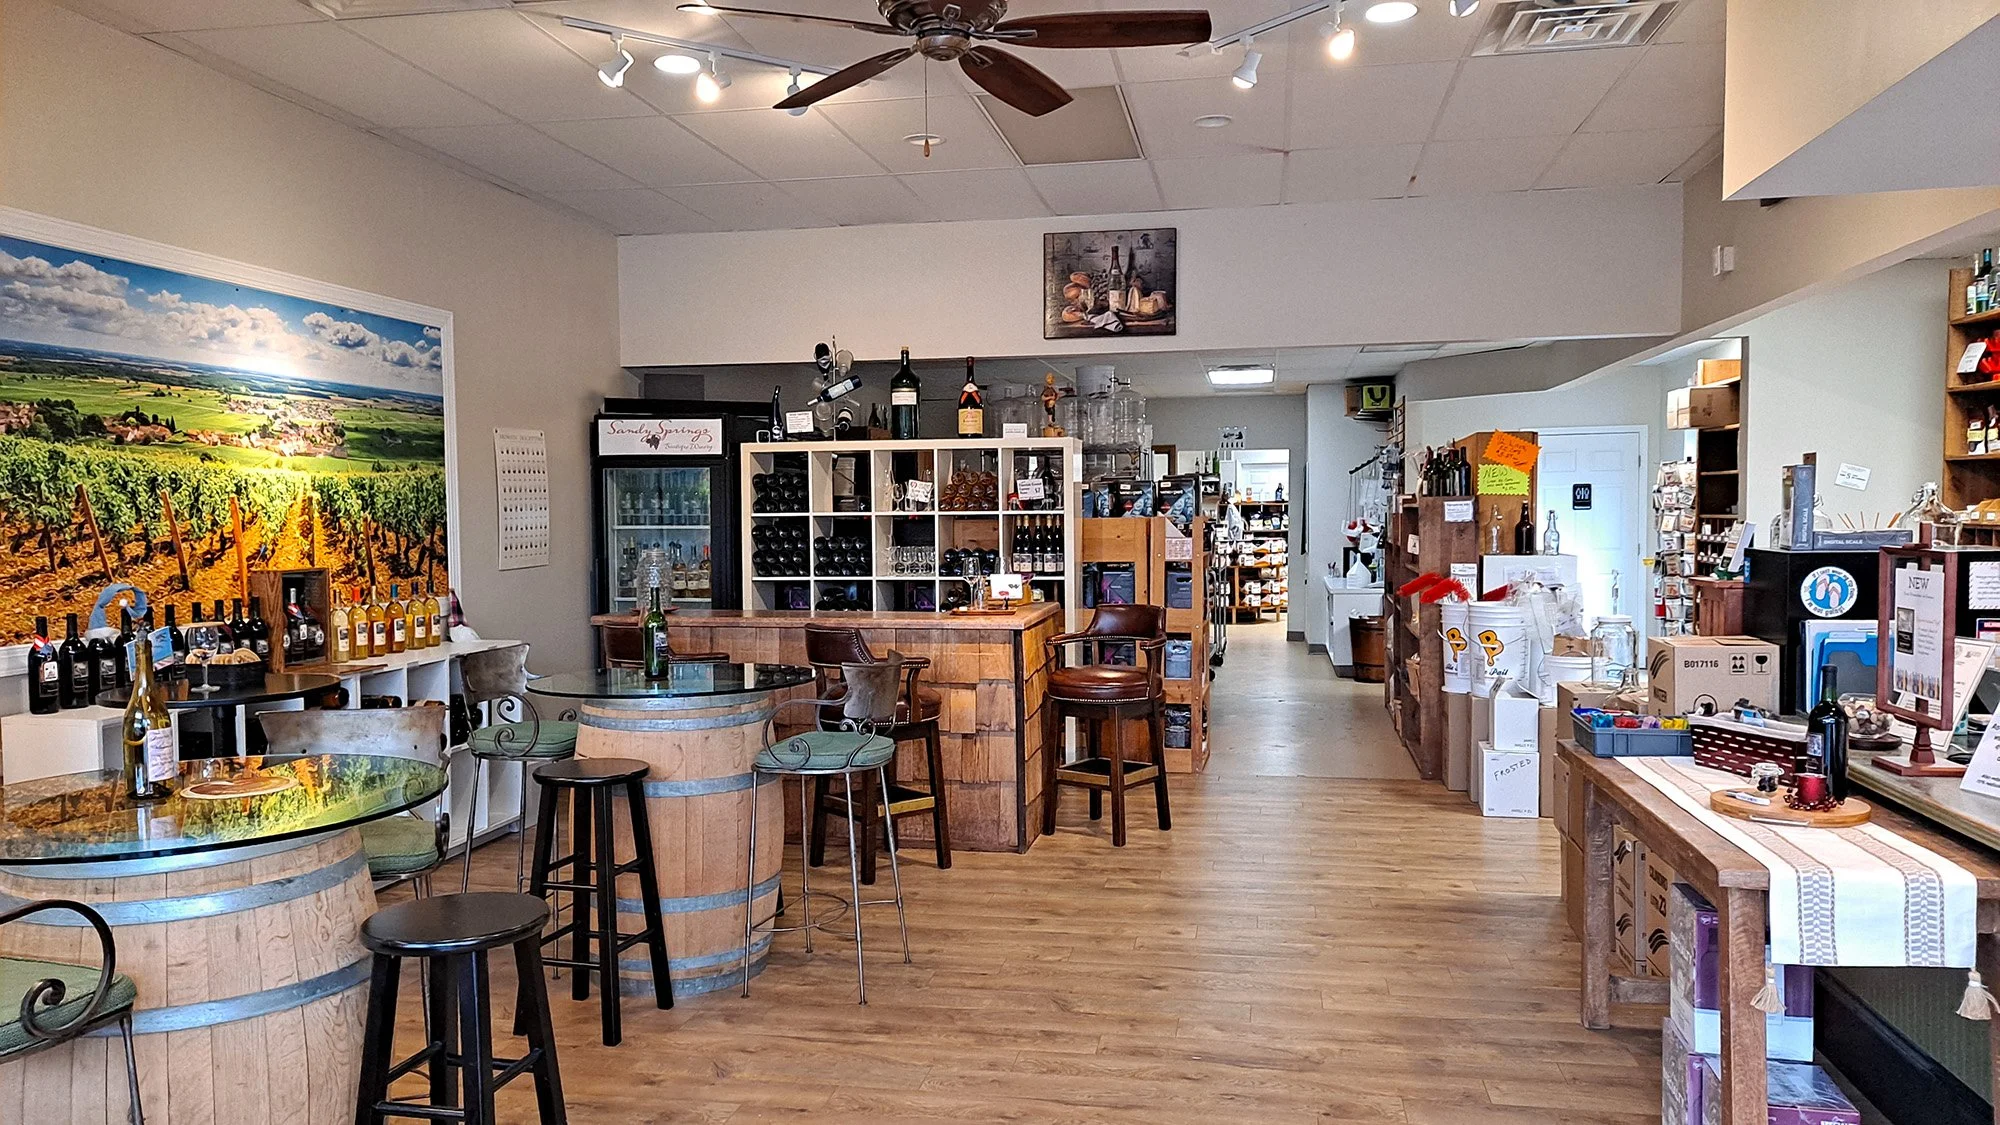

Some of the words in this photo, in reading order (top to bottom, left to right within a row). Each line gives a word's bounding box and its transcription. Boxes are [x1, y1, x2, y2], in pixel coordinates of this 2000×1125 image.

[607, 420, 651, 442] Sandy
[656, 420, 713, 443] Springs
[1908, 576, 1930, 589] NEW
[1684, 660, 1719, 668] B017116
[1489, 668, 1508, 676] Pail
[1494, 758, 1531, 781] FROSTED
